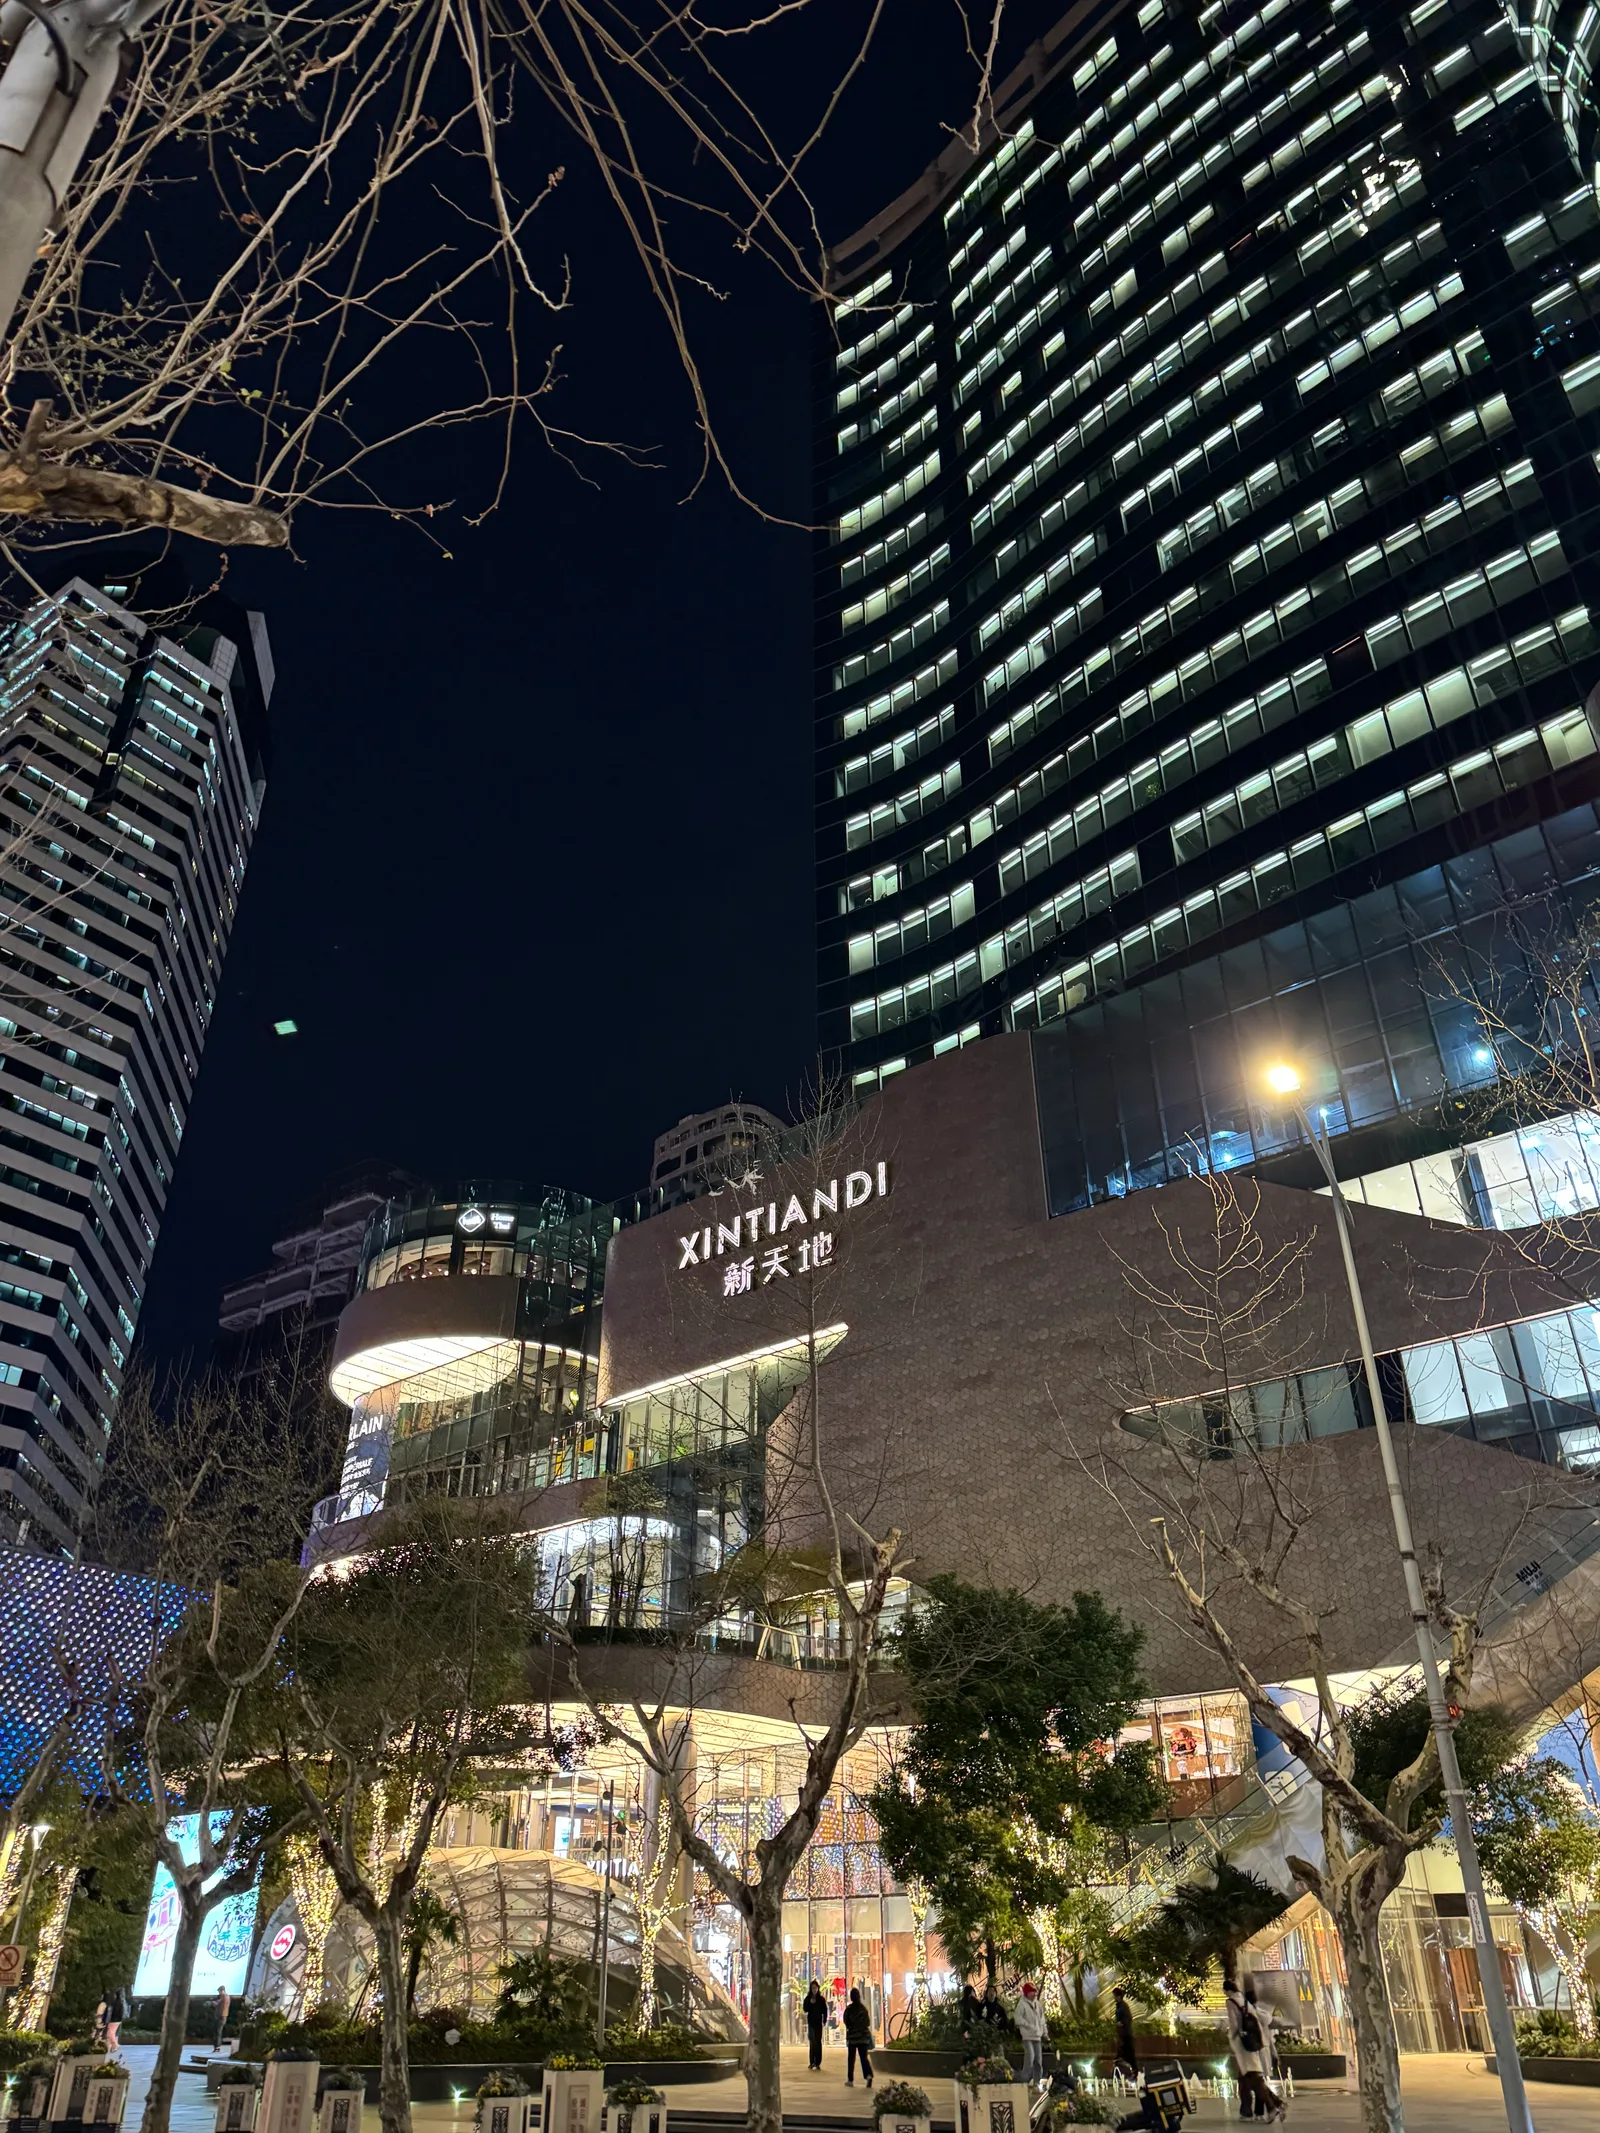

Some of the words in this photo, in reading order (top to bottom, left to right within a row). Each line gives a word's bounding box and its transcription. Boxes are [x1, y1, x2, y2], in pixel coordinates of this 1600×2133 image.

[679, 1162, 886, 1270] XINTIANDI
[723, 1231, 833, 1297] 新天地
[1516, 1560, 1541, 1582] MUJI
[1165, 1841, 1187, 1862] MUJI
